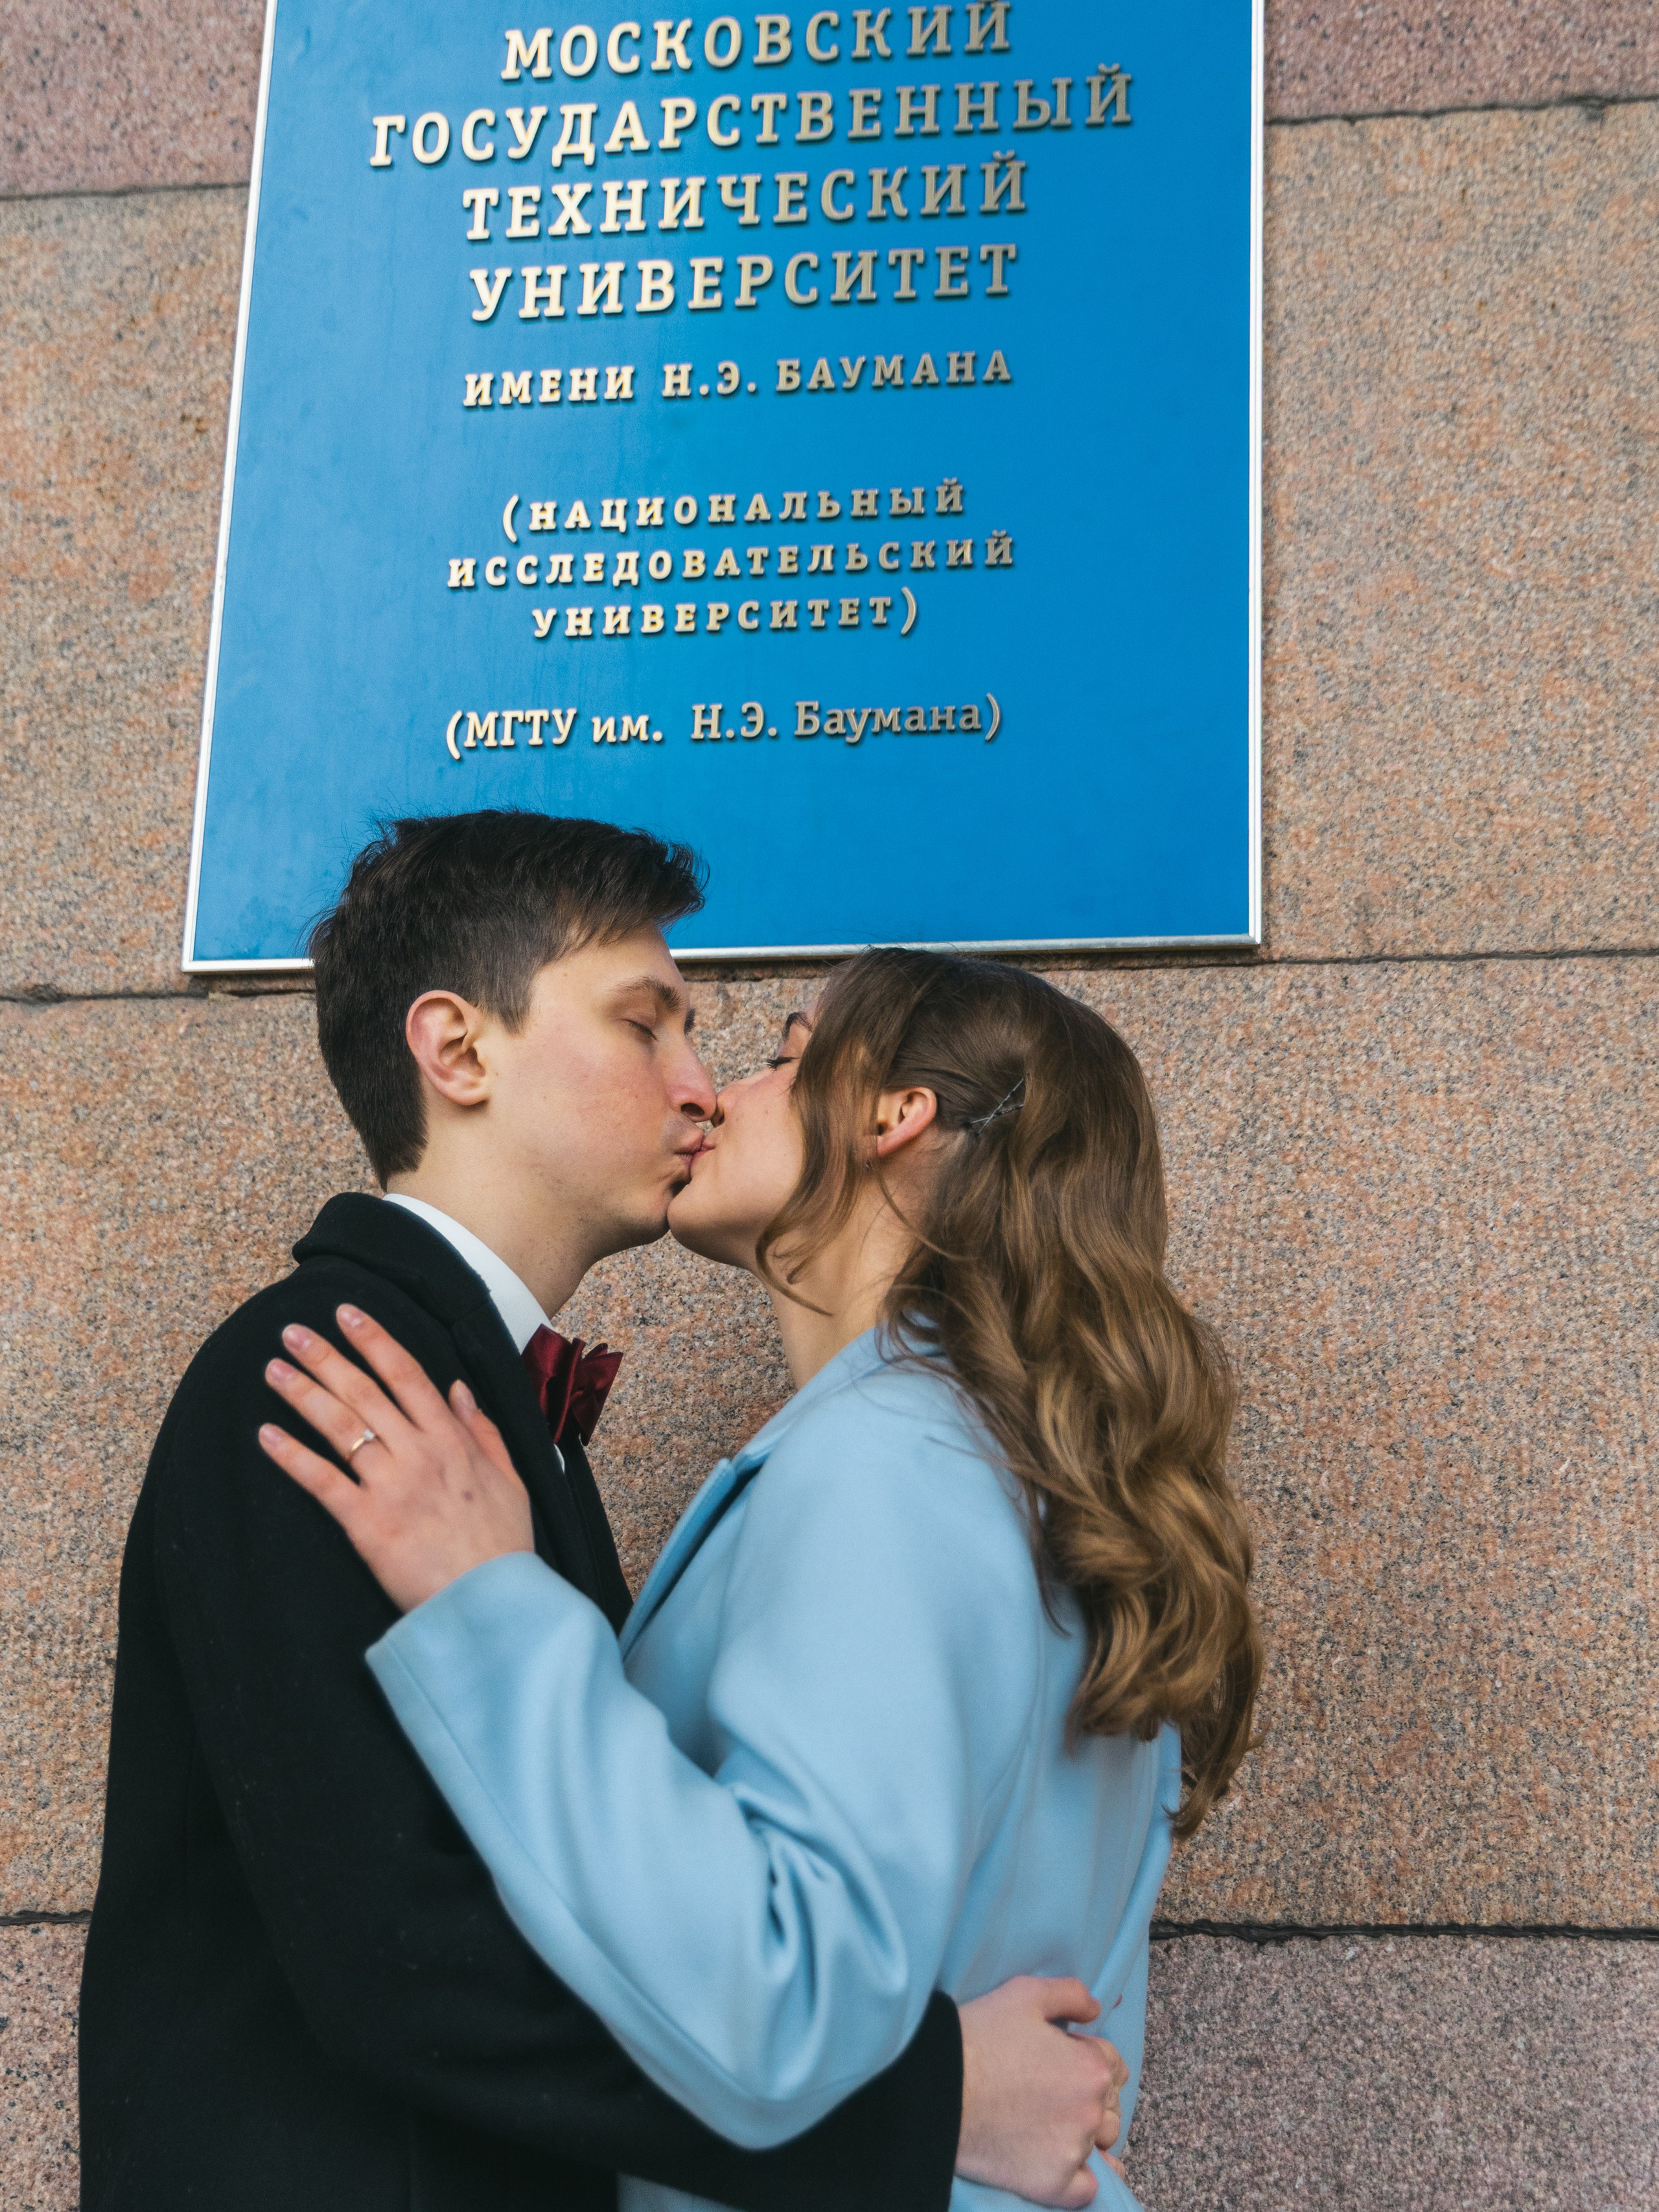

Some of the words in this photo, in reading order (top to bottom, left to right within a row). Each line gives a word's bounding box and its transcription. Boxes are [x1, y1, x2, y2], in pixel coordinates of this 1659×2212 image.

[501, 0, 1010, 80] МОСКОВСКИЙ
[369, 64, 1131, 167] ГОСУДАРСТВЕННЫЙ
[463, 151, 1025, 241] ТЕХНИЧЕСКИЙ
[469, 244, 1015, 321] УНИВЕРСИТЕТ
[463, 366, 634, 408] ИМЕНИ
[662, 361, 755, 399] Н.Э.
[776, 351, 1010, 393] БАУМАНА
[503, 478, 962, 542] (НАЦИОНАЛЬНЫЙ
[447, 531, 1012, 589] ИССЛЕДОВАТЕЛЬСКИЙ
[532, 587, 916, 638] УНИВЕРСИТЕТ)
[446, 708, 577, 761] (МГТУ
[592, 715, 662, 743] им.
[691, 702, 776, 741] Н.Э.
[795, 694, 1000, 745] Баумана)
